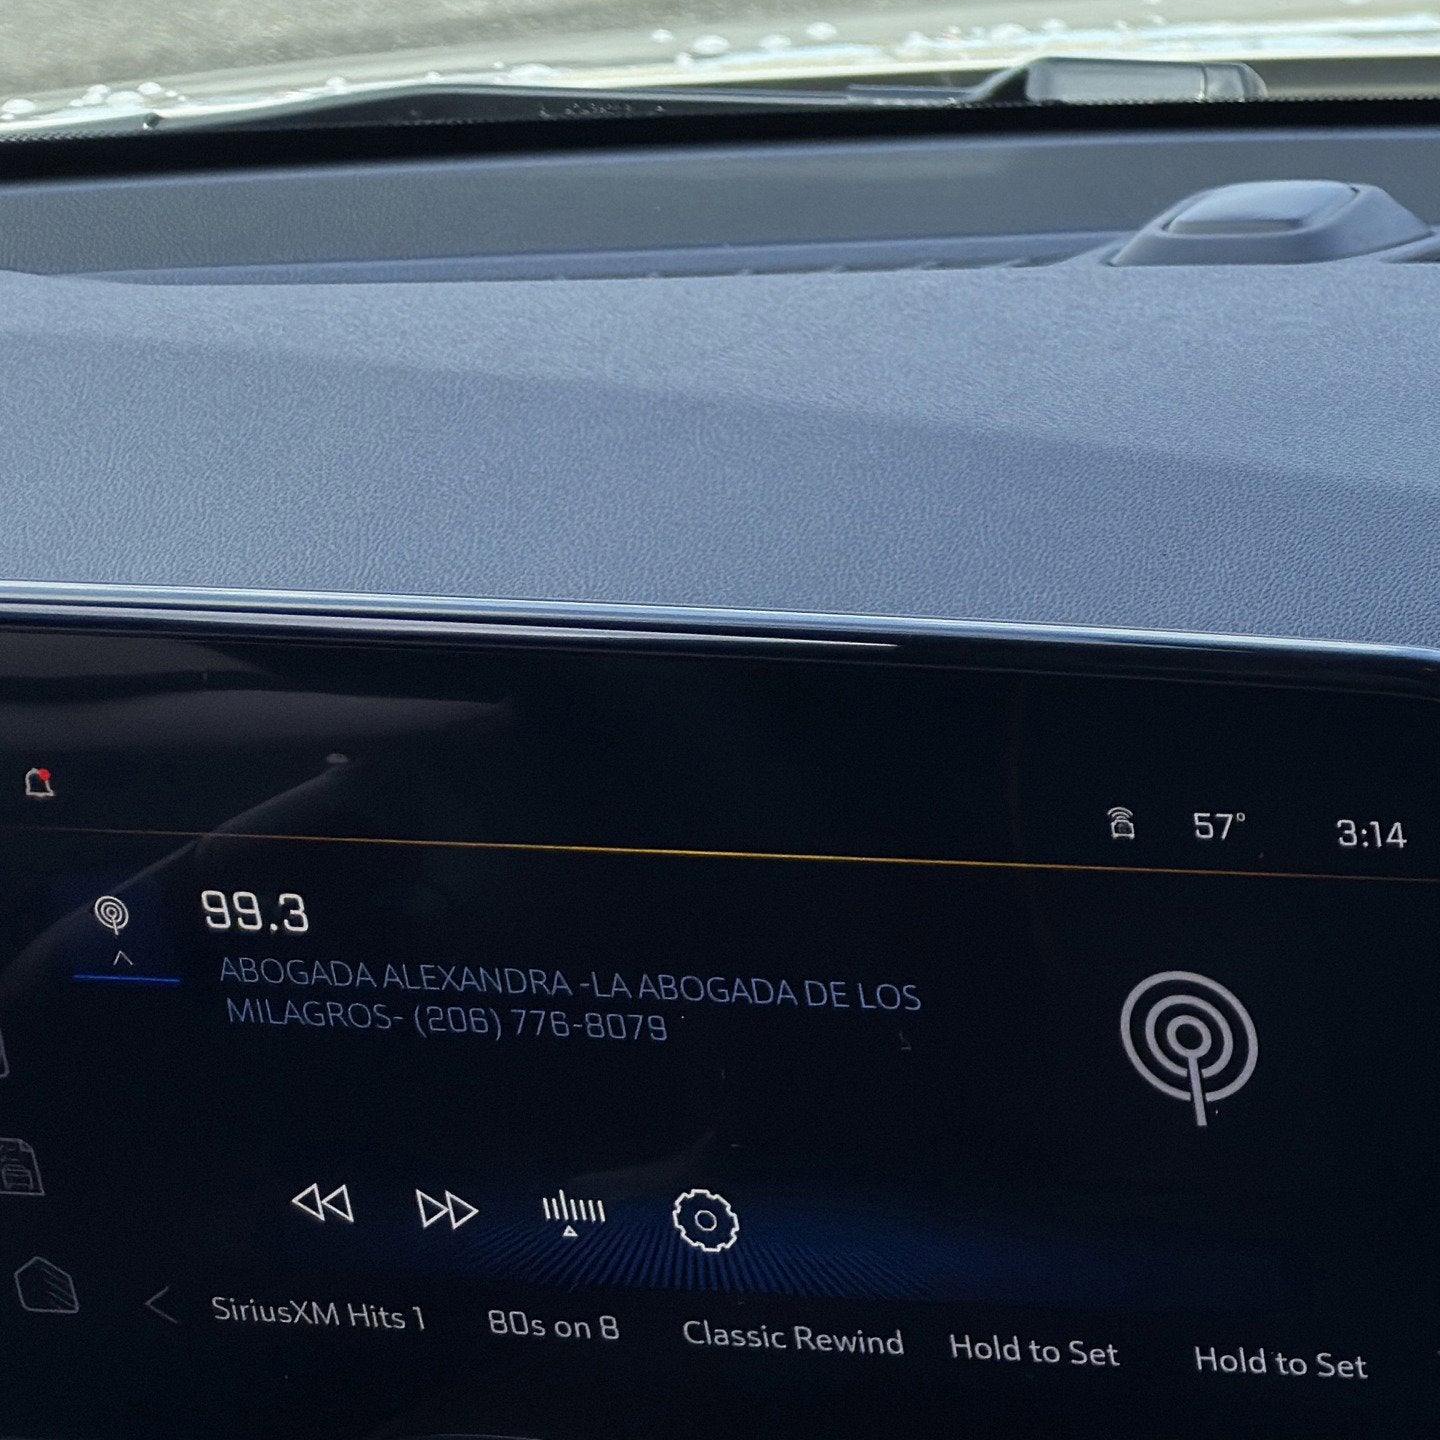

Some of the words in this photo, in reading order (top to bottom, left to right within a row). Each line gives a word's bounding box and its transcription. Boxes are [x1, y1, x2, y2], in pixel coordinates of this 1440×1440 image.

[1193, 812, 1246, 840] 57°
[1336, 818, 1408, 849] 3:14
[200, 889, 310, 933] 99.3
[219, 956, 378, 988] ABOGADA
[382, 963, 573, 996] ALEXANDRA
[579, 971, 633, 999] -LA
[638, 973, 799, 1006] ABOGADA
[804, 979, 850, 1009] DE
[857, 982, 922, 1012] LOS
[226, 997, 404, 1030] MILAGROS-
[413, 1005, 502, 1041] (206)
[510, 1008, 668, 1042] 776-8079
[211, 1296, 341, 1326] SiriusXM
[347, 1302, 406, 1330] Hits
[412, 1305, 426, 1331] 1
[487, 1309, 547, 1337] 80s
[553, 1320, 592, 1340] on
[598, 1314, 620, 1341] 8
[682, 1319, 788, 1350] Classic
[793, 1325, 905, 1355] Rewind
[949, 1333, 1022, 1362] Hold
[1028, 1339, 1061, 1364] to
[1068, 1339, 1121, 1367] Set
[1194, 1346, 1268, 1374] Hold
[1274, 1352, 1308, 1376] to
[1315, 1352, 1369, 1380] Set
